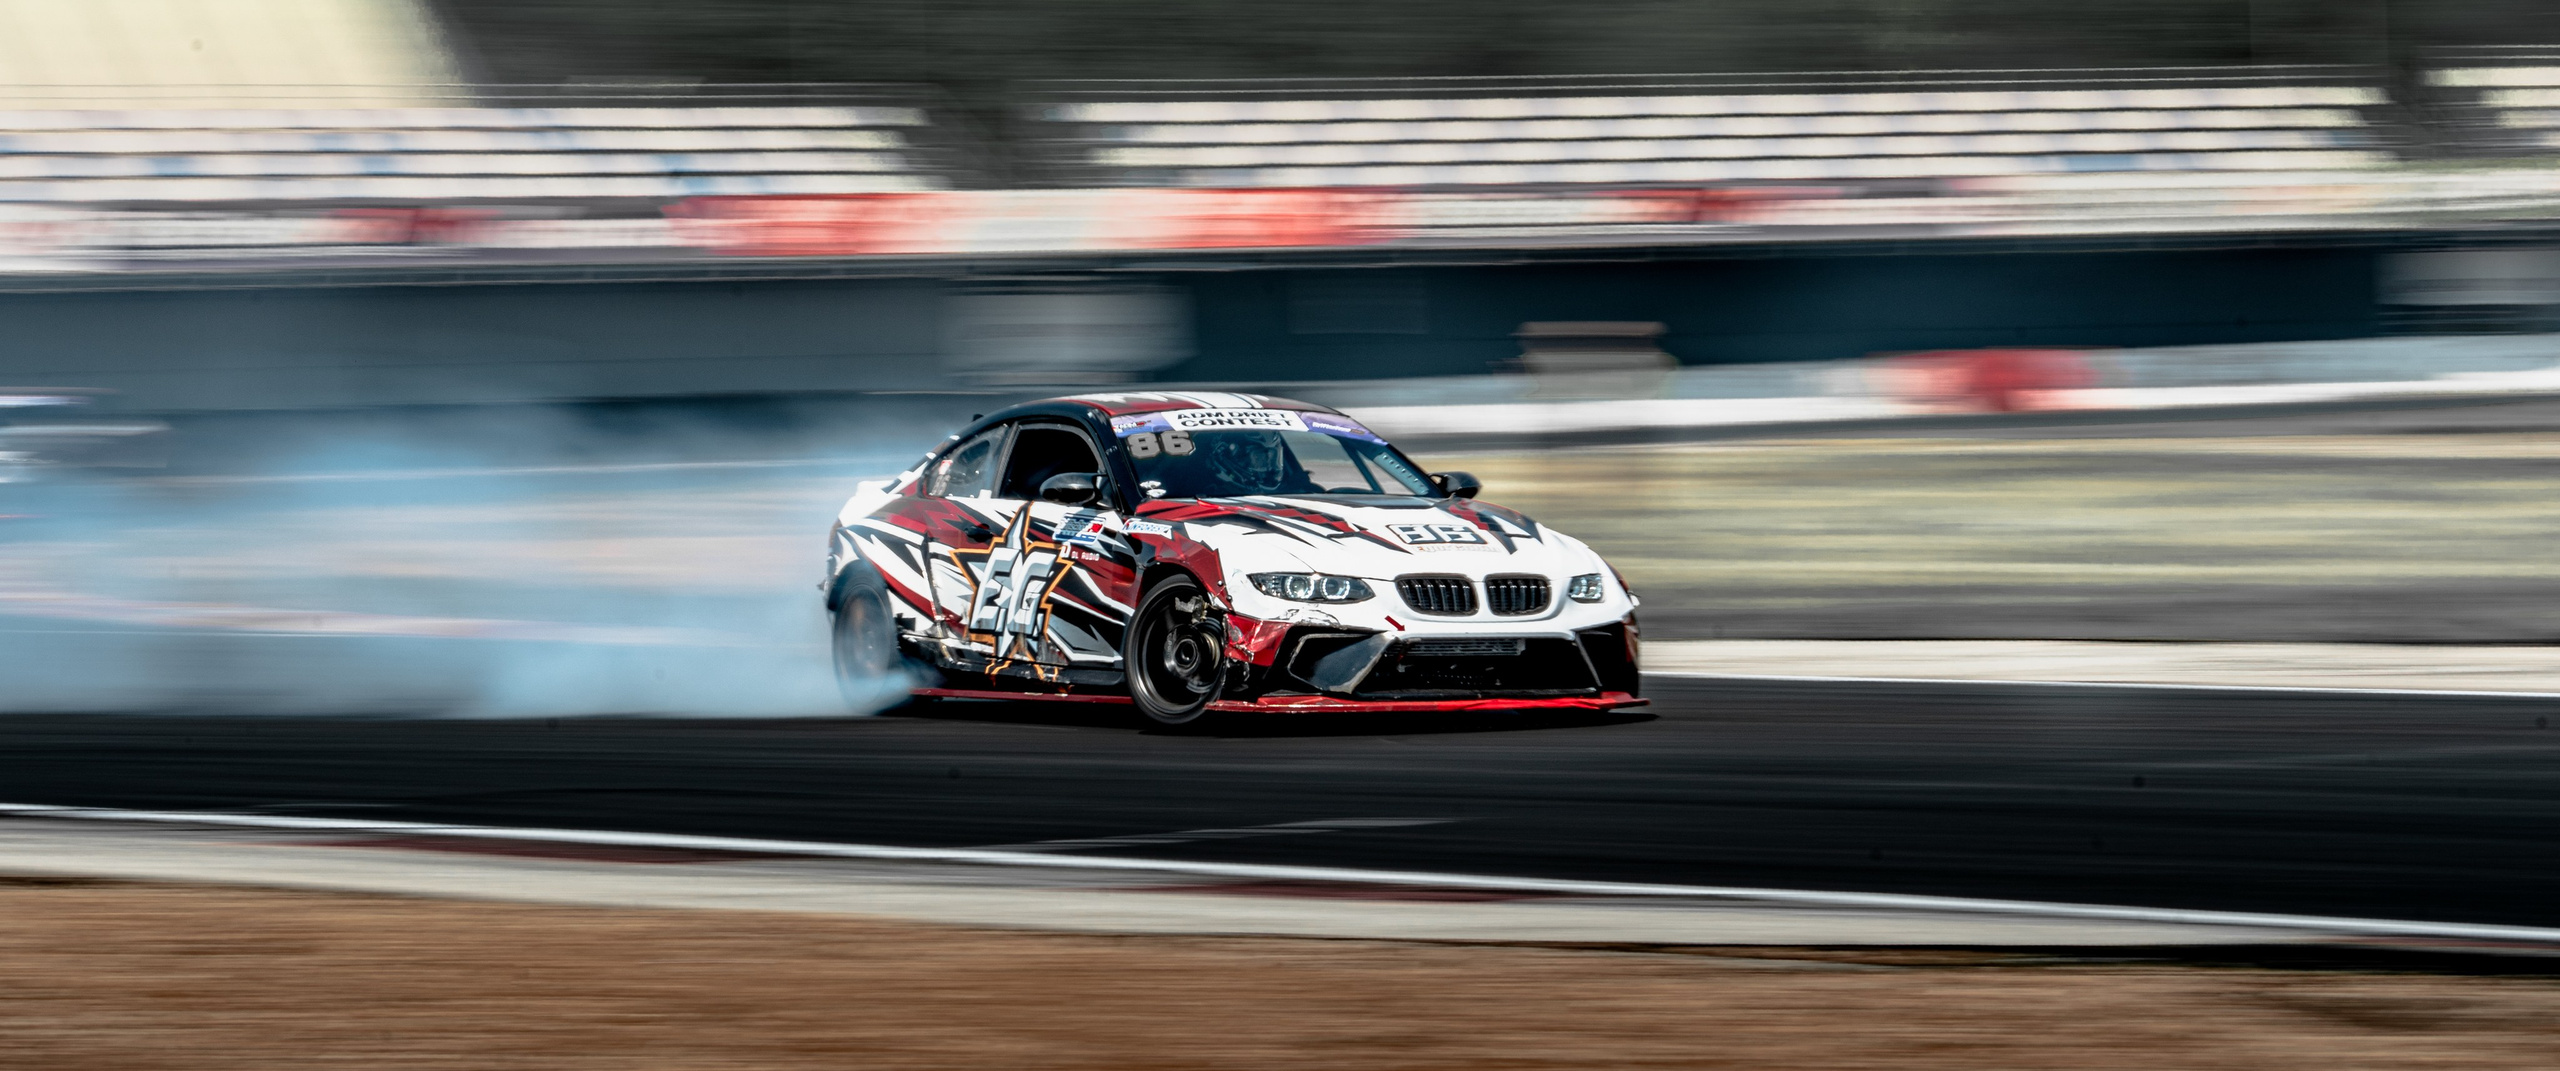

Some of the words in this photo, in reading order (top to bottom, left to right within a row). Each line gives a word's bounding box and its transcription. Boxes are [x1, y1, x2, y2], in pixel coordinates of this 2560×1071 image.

[1177, 411, 1224, 420] ADM
[1228, 411, 1286, 419] DRIFT
[1181, 418, 1292, 427] CONTEST
[1126, 431, 1196, 459] 86
